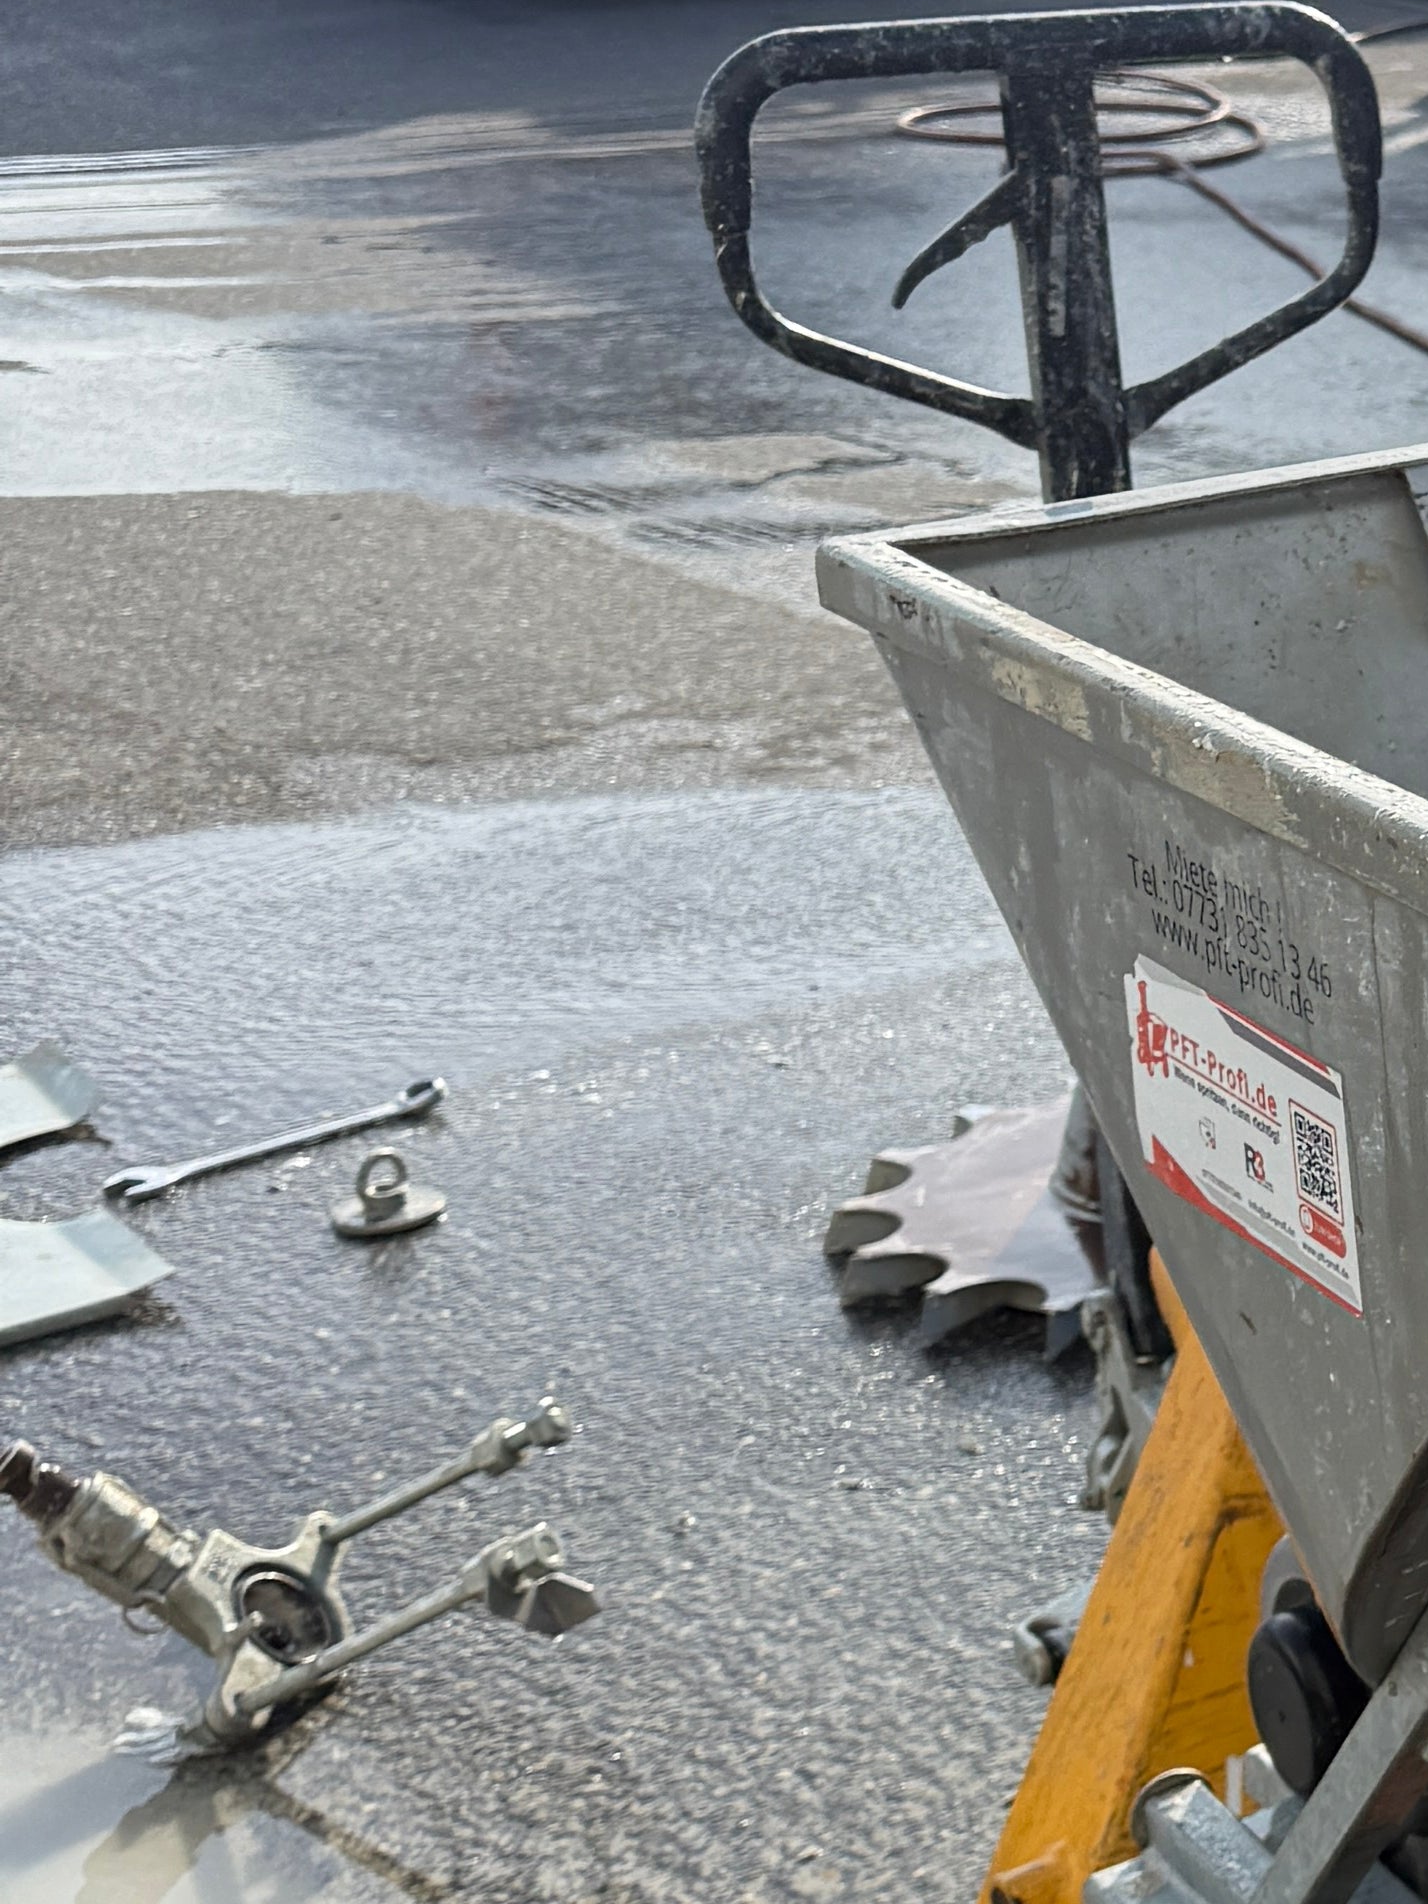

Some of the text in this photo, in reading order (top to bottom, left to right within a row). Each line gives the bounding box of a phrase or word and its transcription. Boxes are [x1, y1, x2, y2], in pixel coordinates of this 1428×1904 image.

[1127, 853, 1333, 998] Tel.: 07731 835 13 46
[1165, 840, 1218, 897] Miete
[1223, 872, 1272, 925] mich
[1151, 908, 1316, 1026] www.pft-profi.de
[1169, 1026, 1279, 1117] PFT-Profi.de
[1243, 1142, 1267, 1182] R3
